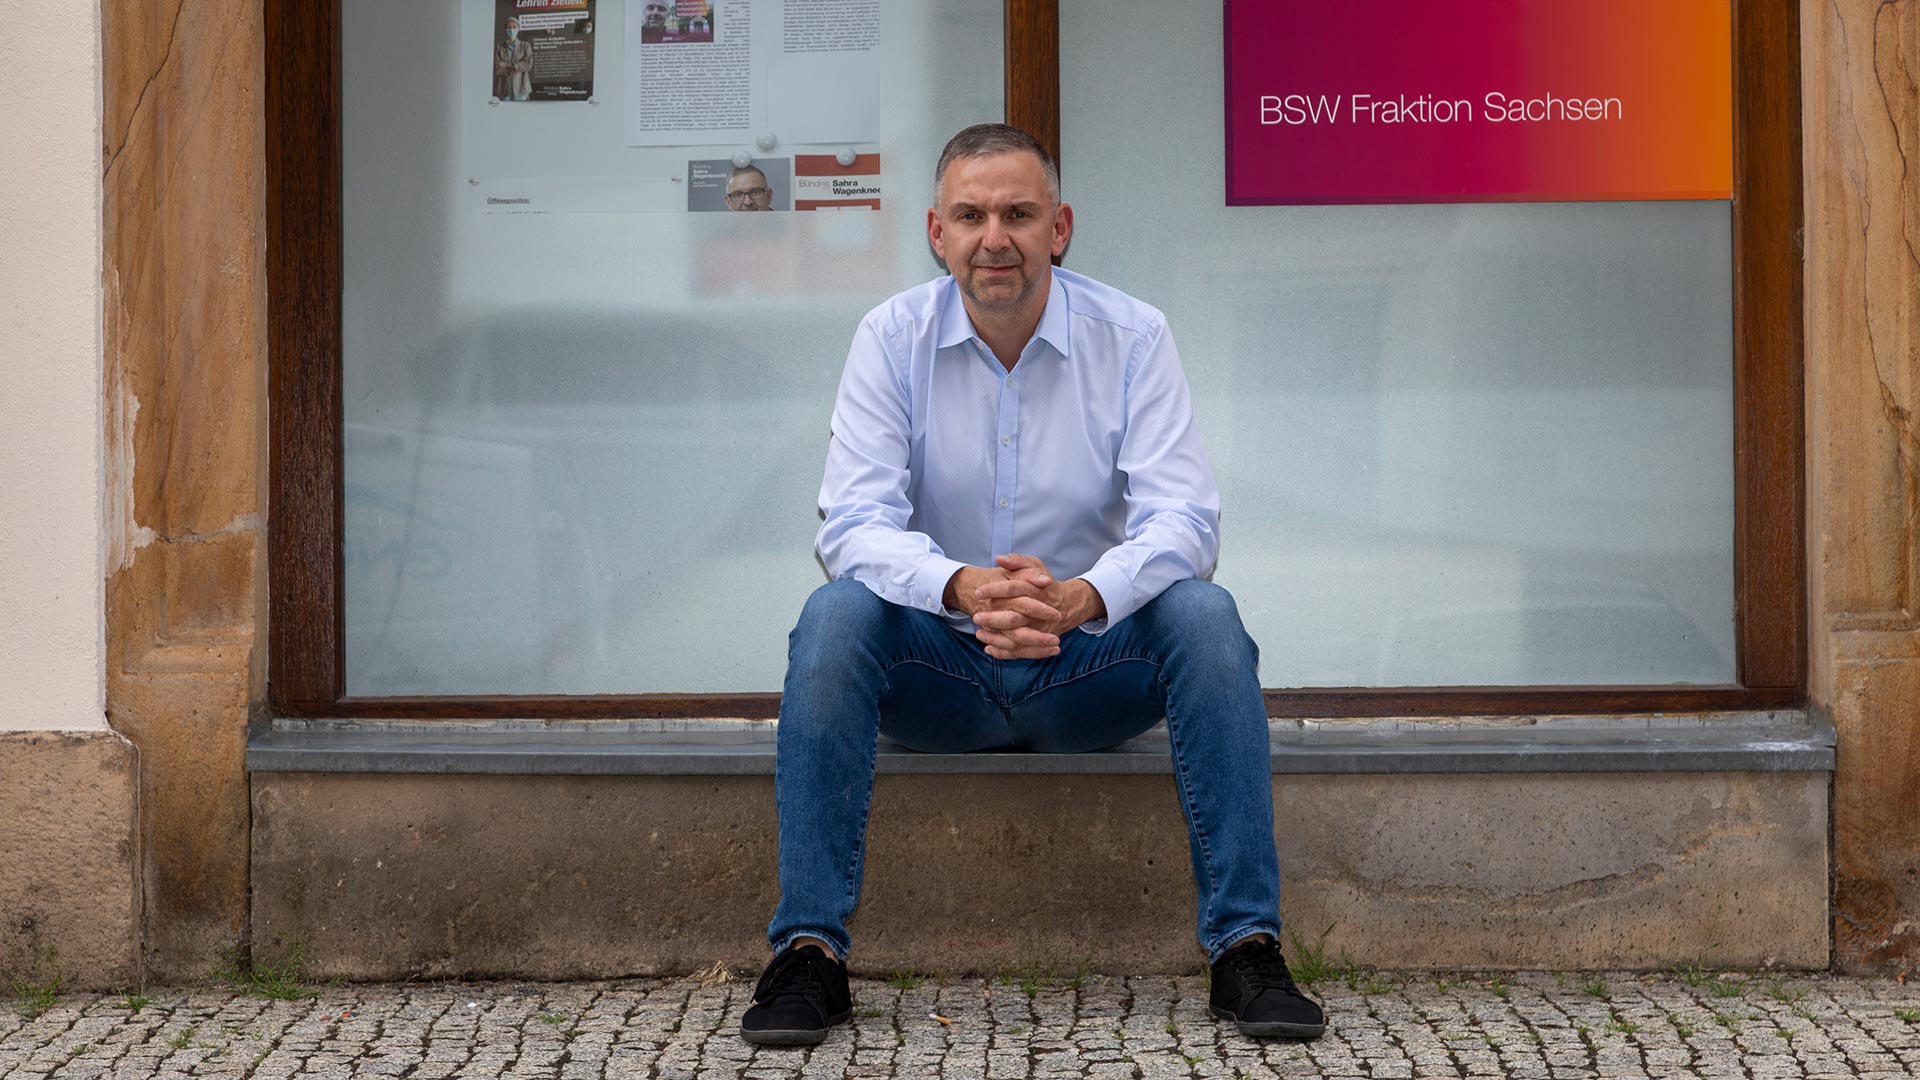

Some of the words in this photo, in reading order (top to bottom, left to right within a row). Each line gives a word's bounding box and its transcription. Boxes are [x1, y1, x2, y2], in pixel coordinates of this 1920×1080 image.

[1260, 95, 1341, 125] BSW
[1352, 93, 1472, 124] Fraktion
[1484, 92, 1622, 122] Sachsen
[832, 179, 858, 187] Sahra
